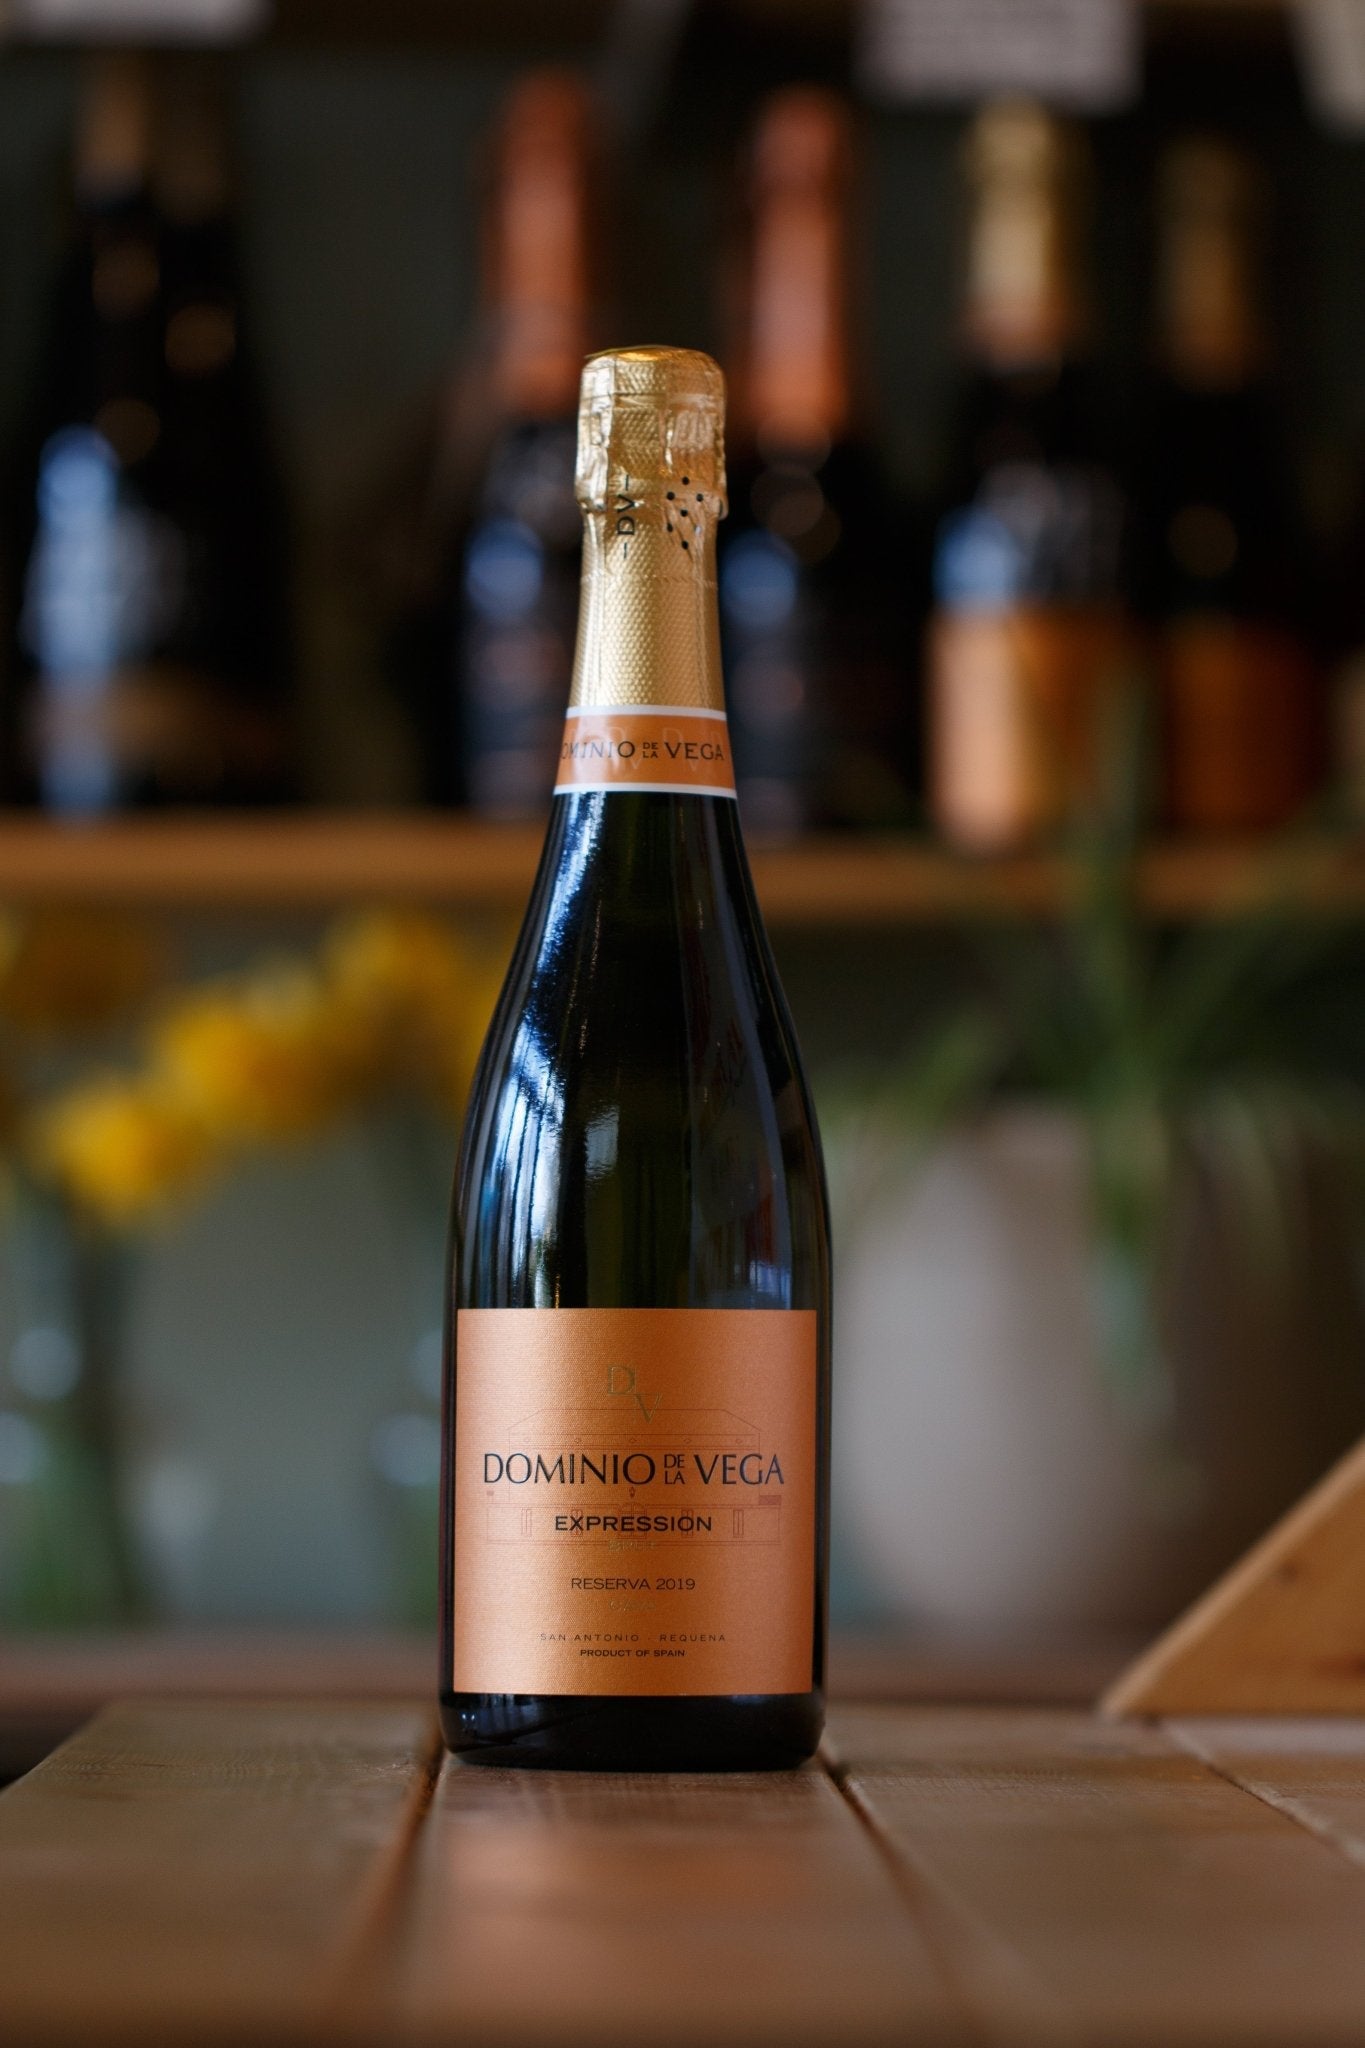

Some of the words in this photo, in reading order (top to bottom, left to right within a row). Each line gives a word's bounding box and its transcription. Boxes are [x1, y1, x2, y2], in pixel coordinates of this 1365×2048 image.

[642, 742, 659, 750] DE
[663, 741, 725, 761] VEGA
[642, 750, 659, 759] LA
[483, 1452, 656, 1485] DOMINIO
[663, 1453, 685, 1469] DE
[693, 1453, 785, 1485] VEGA
[663, 1470, 686, 1485] LA
[555, 1515, 712, 1532] EXPRESSION
[571, 1577, 650, 1591] RESERVA
[656, 1577, 696, 1591] 2019
[540, 1633, 567, 1643] SAN
[573, 1633, 640, 1643] ANTONIO
[659, 1633, 726, 1643] REQUENA
[580, 1649, 631, 1657] PRODUCT
[635, 1649, 650, 1657] OF
[653, 1649, 685, 1657] SPAIN
